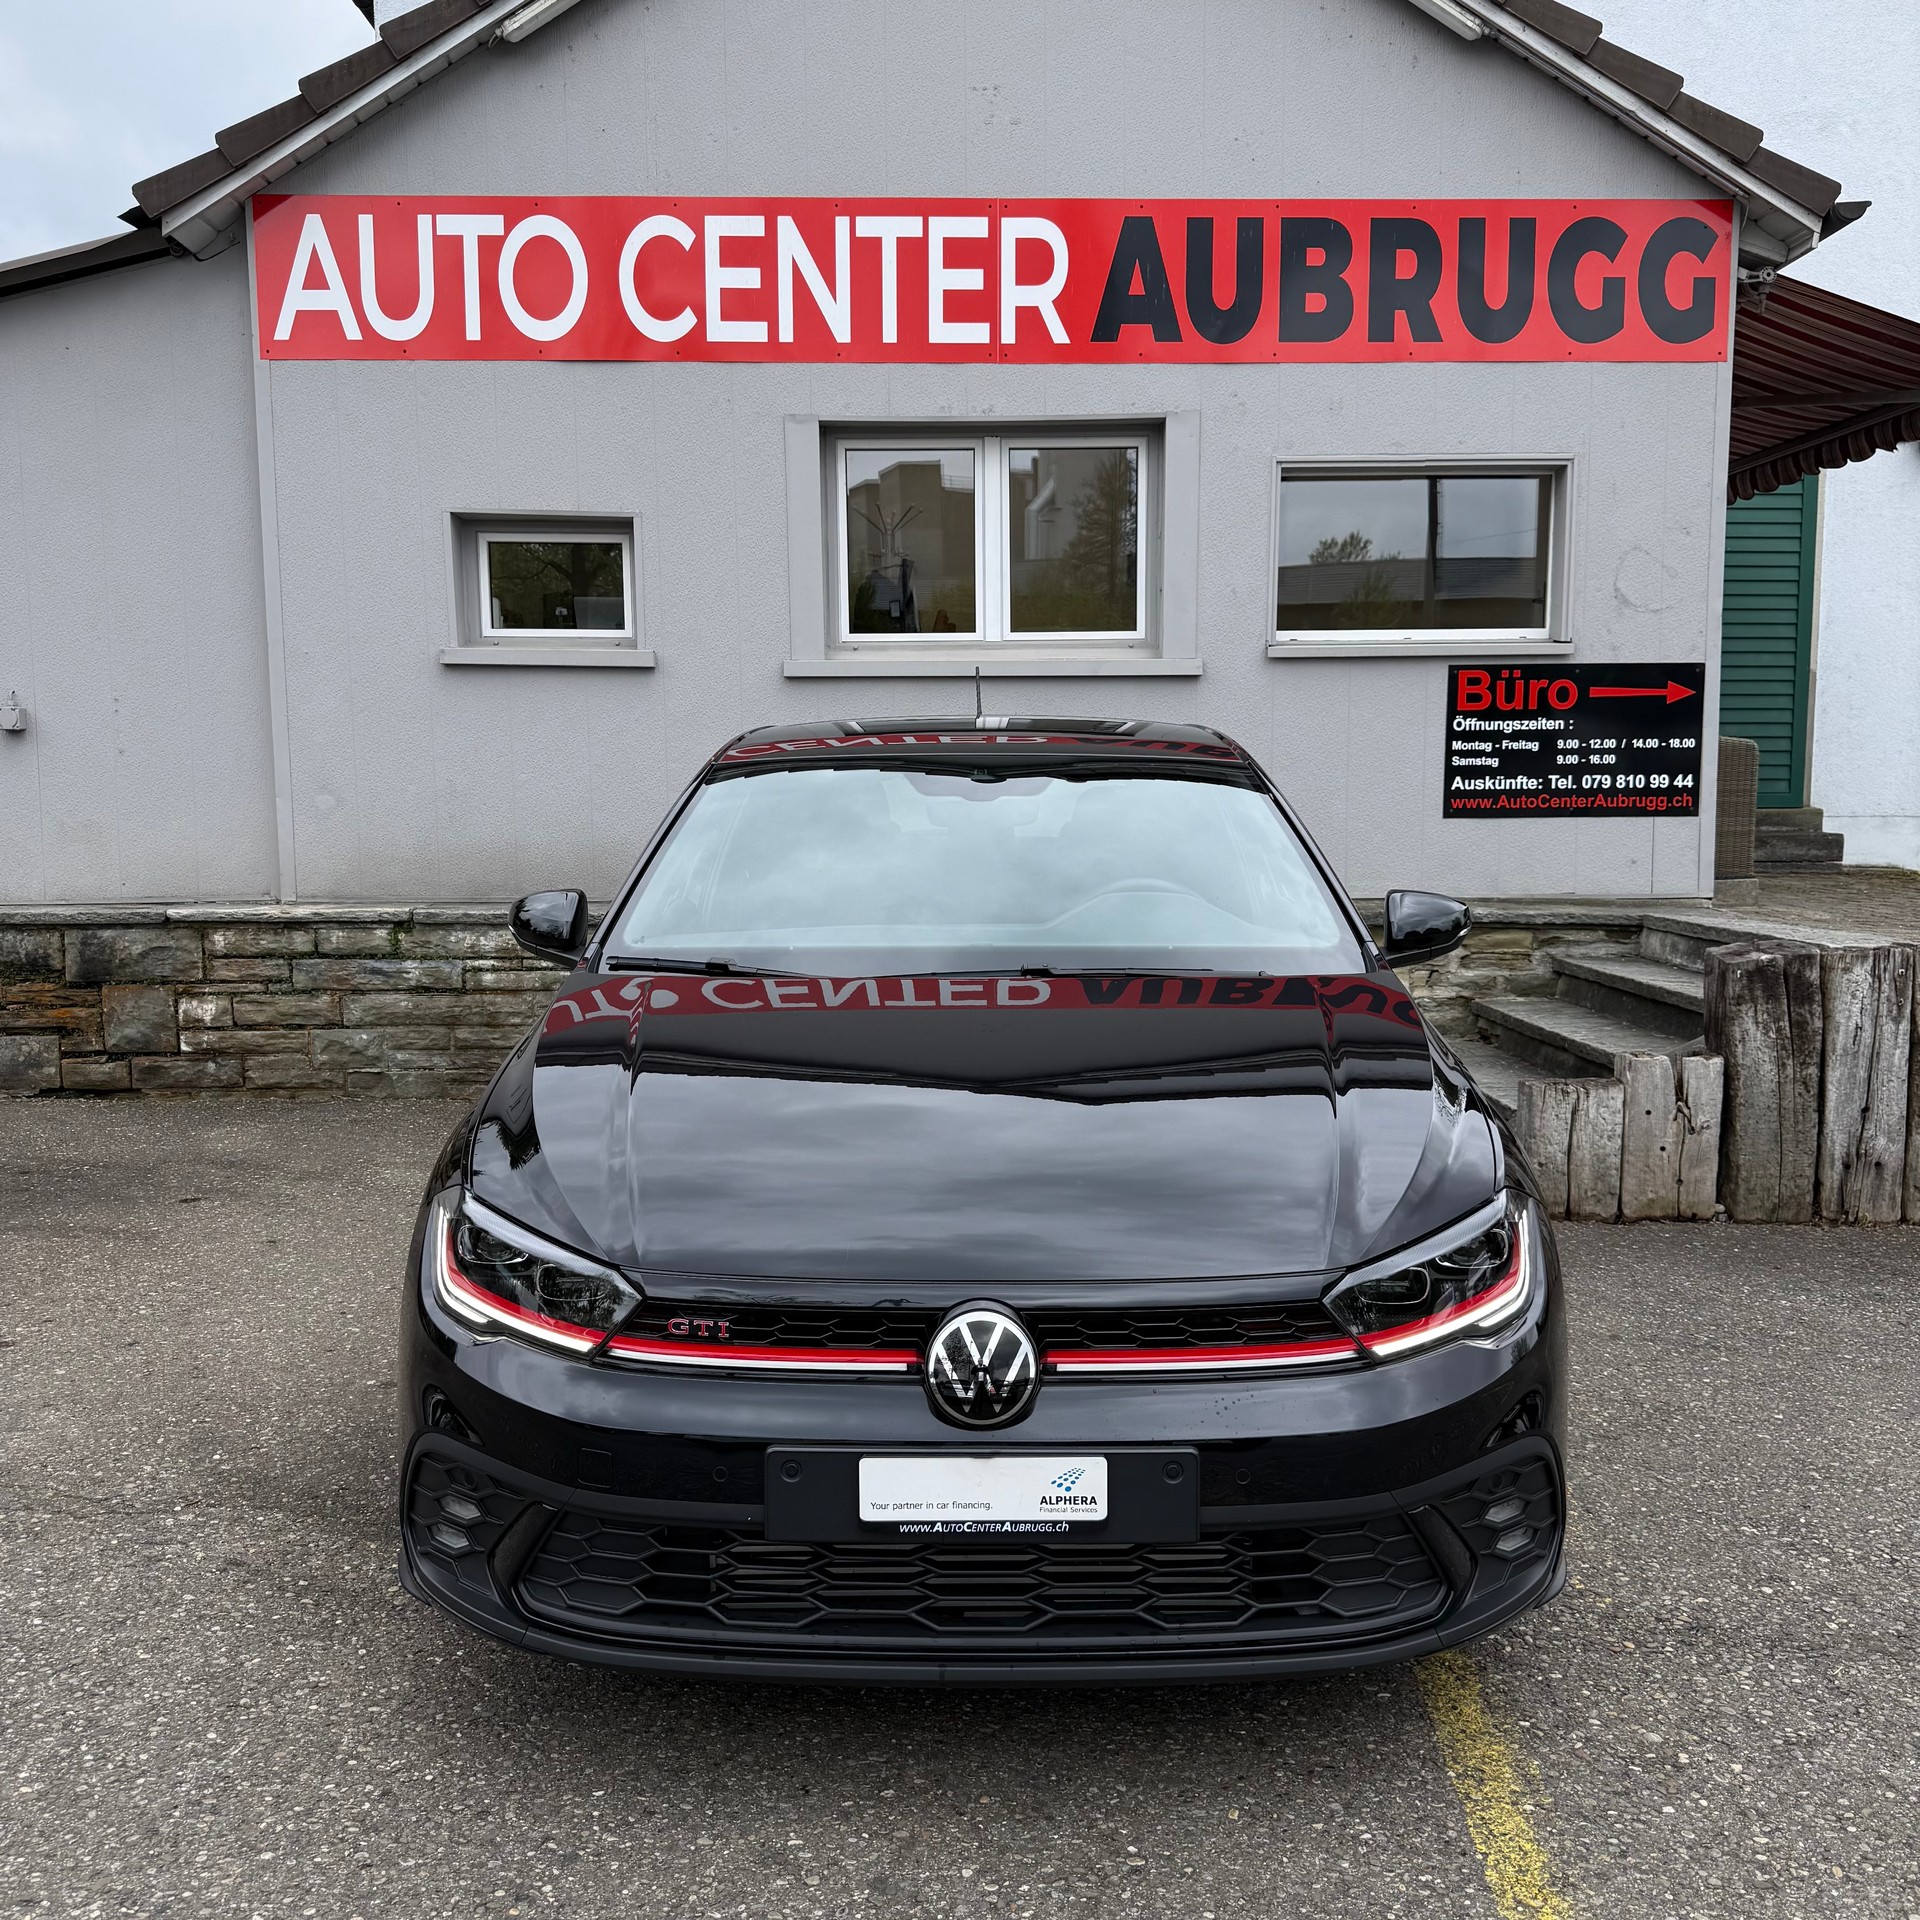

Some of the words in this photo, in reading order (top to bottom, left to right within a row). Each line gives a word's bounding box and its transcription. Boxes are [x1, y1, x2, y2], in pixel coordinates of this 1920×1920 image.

[273, 213, 588, 342] AUTO
[618, 214, 1071, 345] CENTER
[1089, 215, 1720, 344] AUBRUGG
[1457, 669, 1578, 711] Büro
[1452, 715, 1565, 733] Öffnungszeiten
[1451, 740, 1492, 752] Montag
[1502, 740, 1540, 752] Freitag
[1557, 739, 1579, 749] 9.00
[1588, 739, 1616, 749] 12.00
[1631, 738, 1659, 749] 14.00
[1668, 738, 1696, 749] 18.00
[1451, 756, 1499, 768] Samstag
[1556, 754, 1579, 765] 9.00
[1588, 754, 1616, 765] 16.00
[1450, 776, 1543, 790] Auskünfte:
[1548, 775, 1577, 789] Tel.
[1581, 774, 1611, 789] 079
[1615, 774, 1645, 789] 810
[1649, 774, 1669, 788] 99
[1673, 773, 1694, 788] 44
[1450, 793, 1693, 811] www.AutoCenterAubrugg.ch
[667, 1318, 729, 1337] GTI
[870, 1502, 890, 1511] Your
[892, 1501, 923, 1512] partner
[926, 1501, 934, 1510] in
[936, 1502, 949, 1510] car
[952, 1500, 993, 1512] financing.
[1040, 1495, 1098, 1506] ALPHERA
